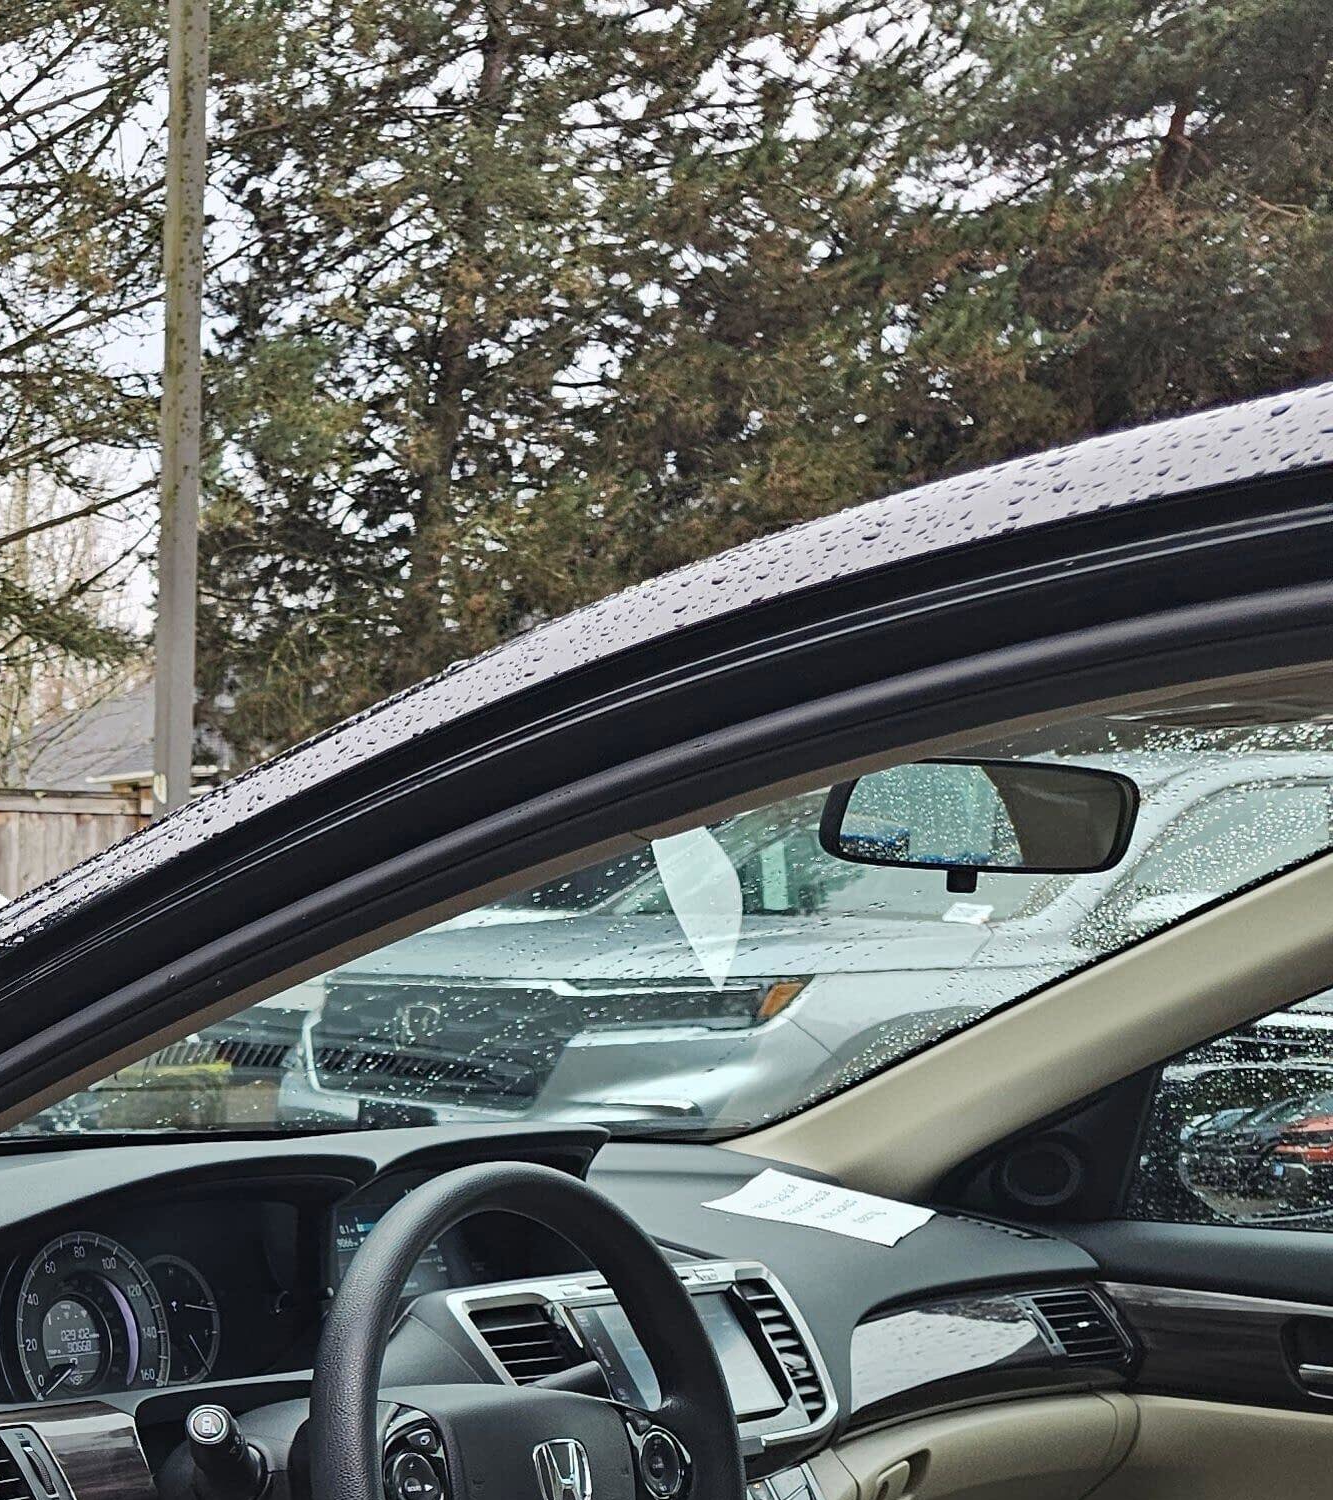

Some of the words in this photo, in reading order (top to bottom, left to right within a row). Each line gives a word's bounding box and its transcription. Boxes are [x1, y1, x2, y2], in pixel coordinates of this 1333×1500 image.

[74, 1246, 85, 1258] 80
[45, 1261, 56, 1274] 60
[102, 1256, 117, 1270] 100
[127, 1284, 142, 1297] 120
[26, 1293, 39, 1306] 40
[142, 1326, 157, 1339] 140
[26, 1338, 38, 1351] 20
[37, 1374, 45, 1387] 0
[141, 1368, 155, 1381] 160
